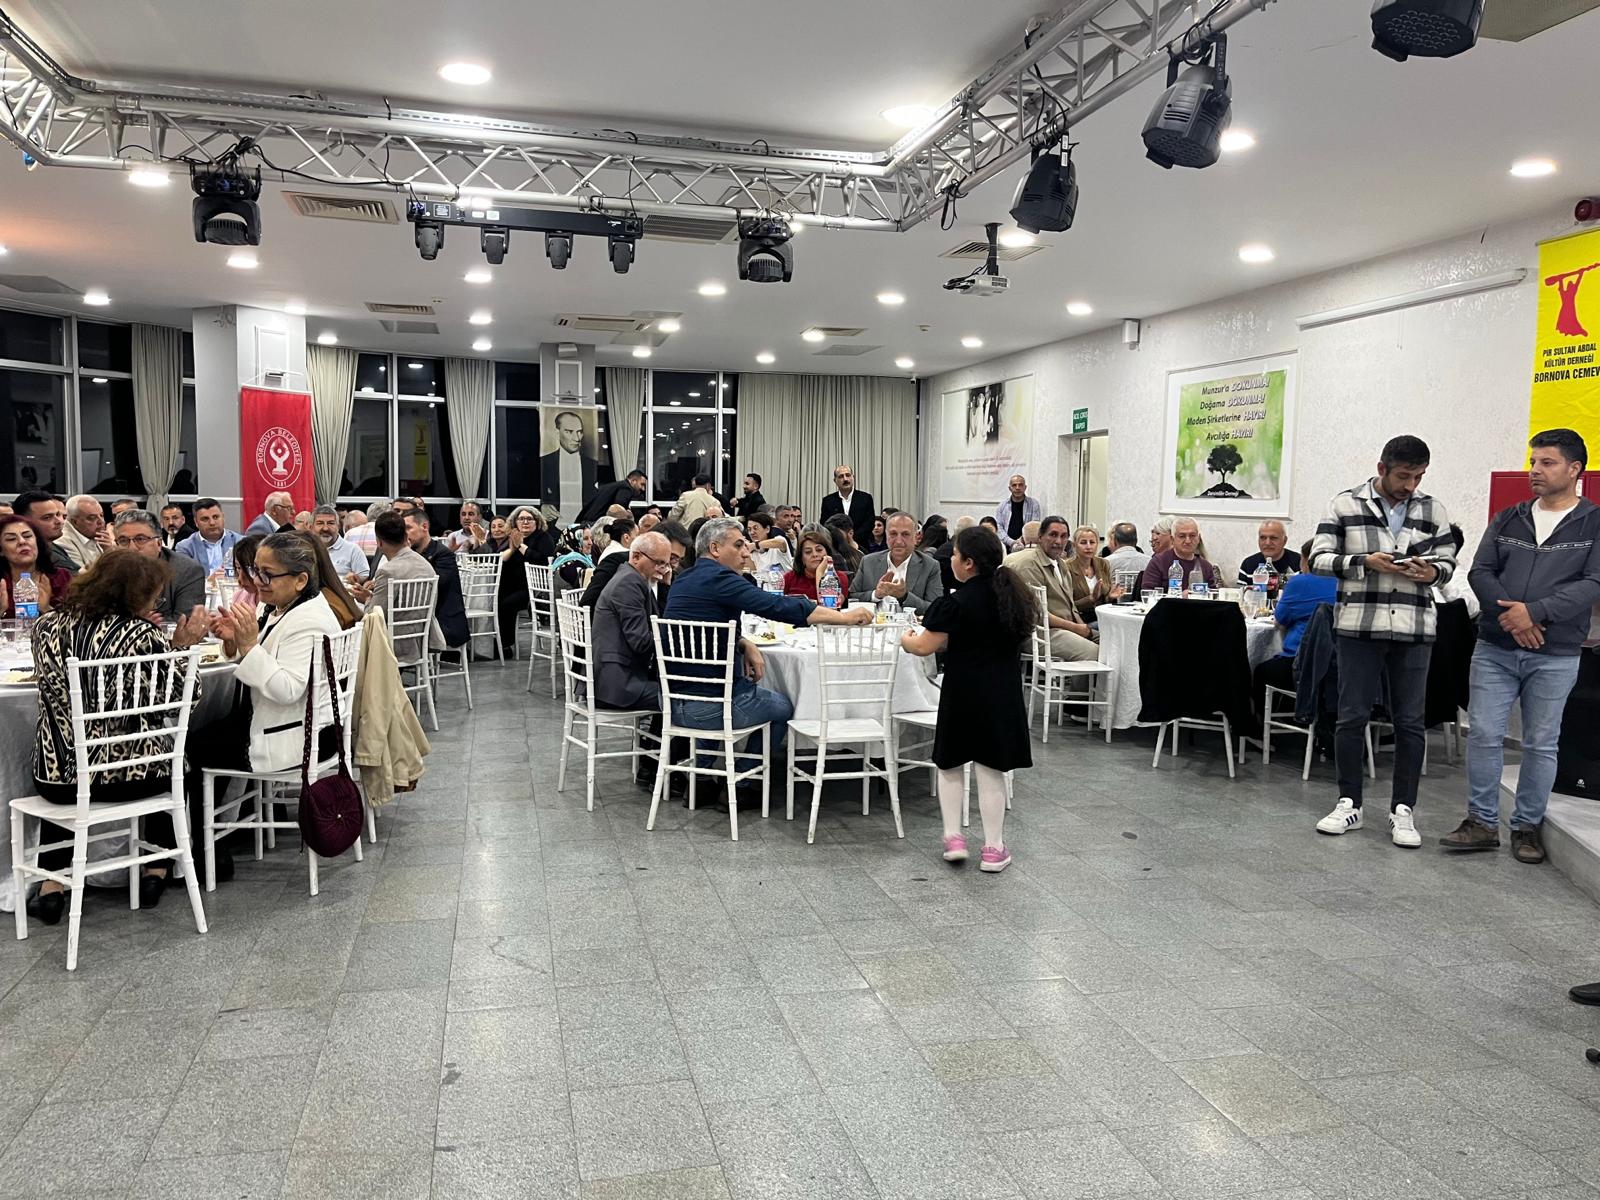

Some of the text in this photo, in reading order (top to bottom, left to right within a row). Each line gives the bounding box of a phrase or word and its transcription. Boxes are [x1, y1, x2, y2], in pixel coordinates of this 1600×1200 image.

[1543, 343, 1596, 357] PİR SULTAN ABDAL
[1544, 354, 1593, 368] KÜLTÜR DERNEĞİ
[1534, 370, 1570, 382] BORNOVA
[1200, 400, 1226, 411] Doğama
[1187, 416, 1206, 425] Maden
[1207, 413, 1241, 425] Şirketlerine
[257, 430, 275, 462] BORNOVA
